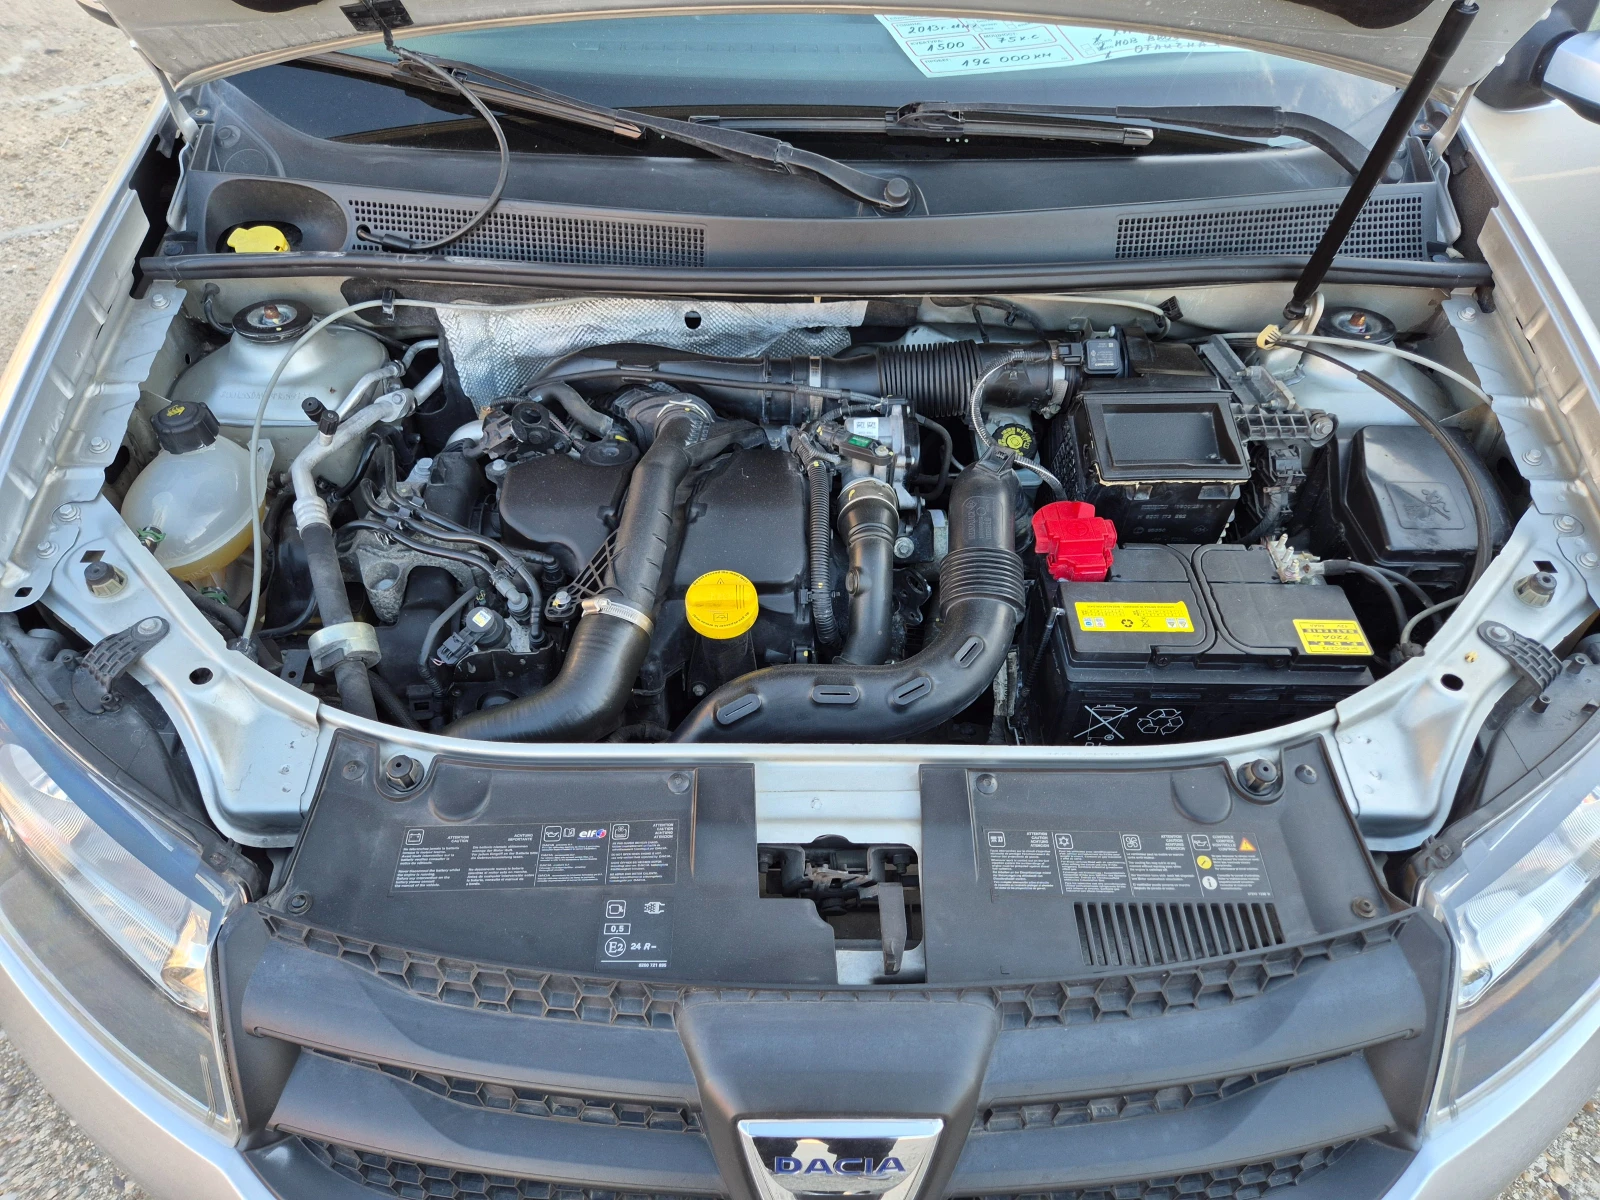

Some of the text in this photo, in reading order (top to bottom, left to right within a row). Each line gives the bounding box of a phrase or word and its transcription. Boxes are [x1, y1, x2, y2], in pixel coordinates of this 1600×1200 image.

[926, 41, 965, 51] 1500
[962, 58, 991, 66] 196
[999, 54, 1031, 63] 000
[578, 829, 597, 838] elf
[610, 925, 625, 933] 0,5
[608, 941, 624, 953] E2
[630, 942, 641, 951] 24
[774, 1156, 906, 1175] DACIA
